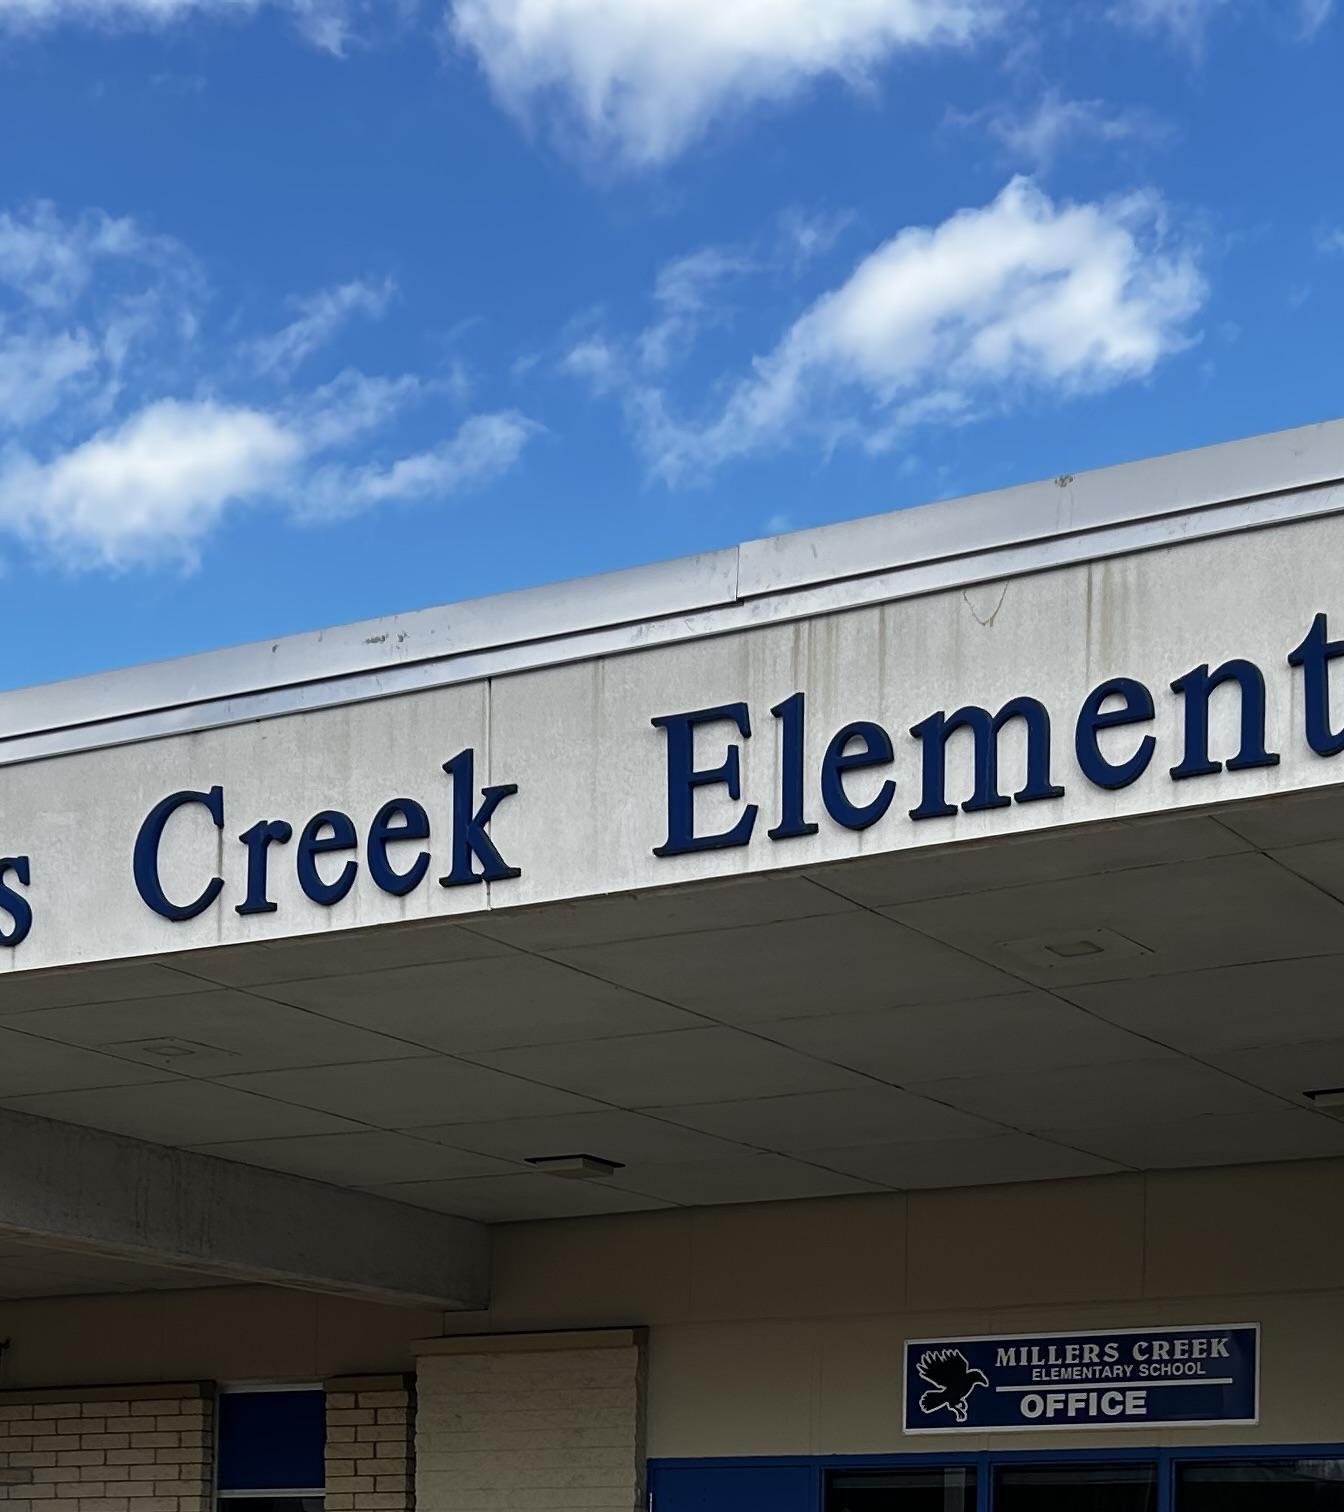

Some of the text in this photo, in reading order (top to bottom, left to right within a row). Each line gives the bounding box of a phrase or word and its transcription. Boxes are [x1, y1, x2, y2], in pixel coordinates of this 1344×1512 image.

[133, 748, 521, 921] Creek
[995, 1338, 1230, 1367] MILLERS CREEK
[1032, 1362, 1206, 1381] ELEMENTARY SCHOOL
[1020, 1391, 1147, 1418] OFFICE
